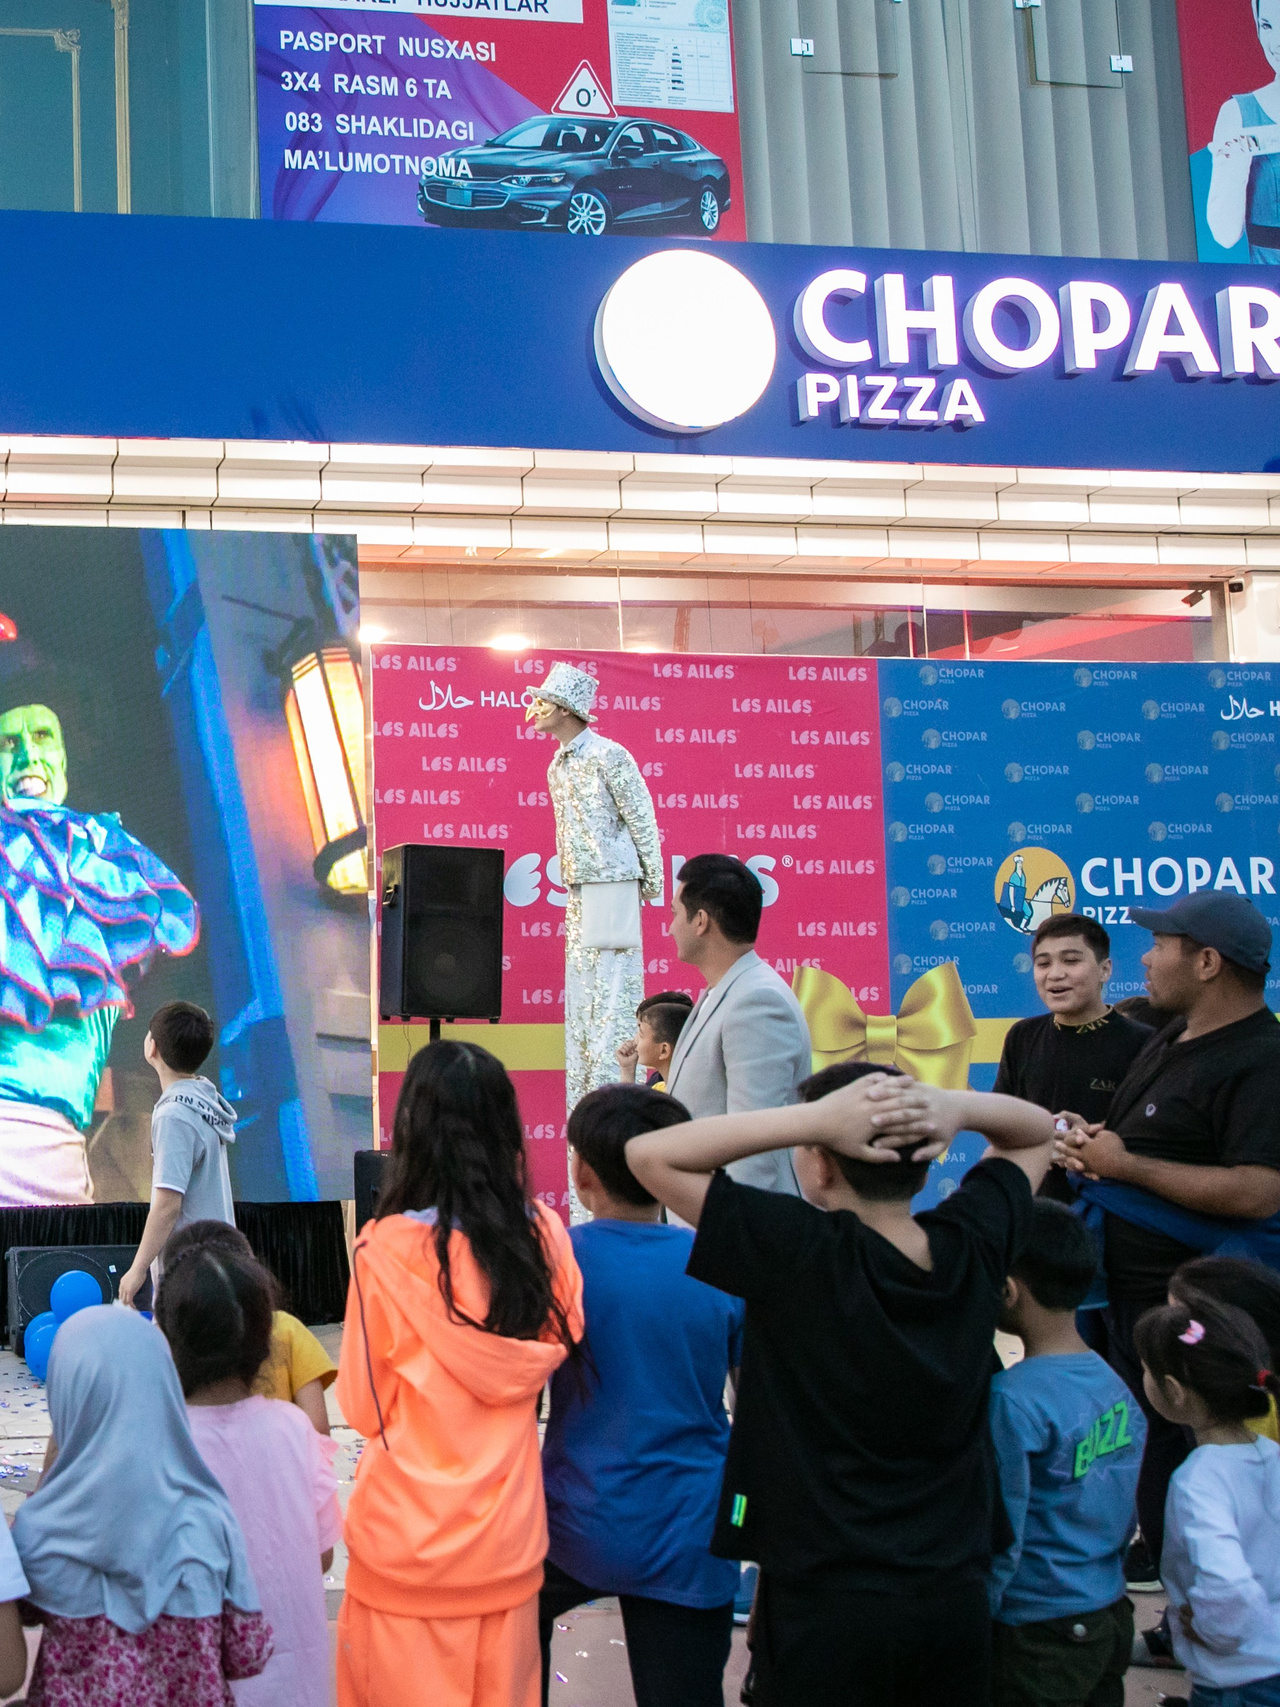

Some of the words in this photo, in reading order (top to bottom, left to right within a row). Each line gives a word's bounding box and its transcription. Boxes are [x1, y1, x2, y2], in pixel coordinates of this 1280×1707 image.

[280, 30, 385, 55] PASPORT
[399, 37, 496, 61] NUSXASI
[281, 71, 321, 92] 3X4
[334, 75, 399, 96] RASM
[405, 78, 418, 97] 6
[423, 79, 452, 99] TA
[285, 112, 322, 133] 083
[336, 114, 474, 141] SHAKLIDAGI
[284, 149, 473, 178] MA'LUMOTNOMA
[797, 268, 1280, 378] CHOPAR
[800, 373, 985, 424] PIZZA
[939, 668, 984, 678] CHOPAR
[1093, 671, 1137, 680] CHOPAR
[1227, 671, 1271, 681] CHOPAR
[419, 680, 474, 710] حلال
[481, 691, 534, 707] HALO
[903, 700, 949, 710] CHOPAR
[1021, 702, 1066, 711] CHOPAR
[1161, 703, 1205, 712] CHOPAR
[1221, 695, 1264, 720] حلال
[942, 732, 987, 741] CHOPAR
[1097, 733, 1141, 742] CHOPAR
[1230, 733, 1274, 742] CHOPAR
[906, 765, 952, 774] CHOPAR
[1024, 765, 1069, 774] CHOPAR
[1165, 765, 1209, 775] CHOPAR
[945, 795, 990, 804] CHOPAR
[1095, 795, 1139, 804] CHOPAR
[1234, 795, 1279, 804] CHOPAR
[908, 824, 955, 834] CHOPAR
[1028, 824, 1072, 834] CHOPAR
[1168, 824, 1212, 833] CHOPAR
[948, 857, 993, 867] CHOPAR
[1081, 857, 1276, 896] CHOPAR
[911, 889, 957, 898] CHOPAR
[950, 922, 996, 931] CHOPAR
[1109, 982, 1146, 991] CHOPA
[1073, 1400, 1132, 1478] BUZZ
